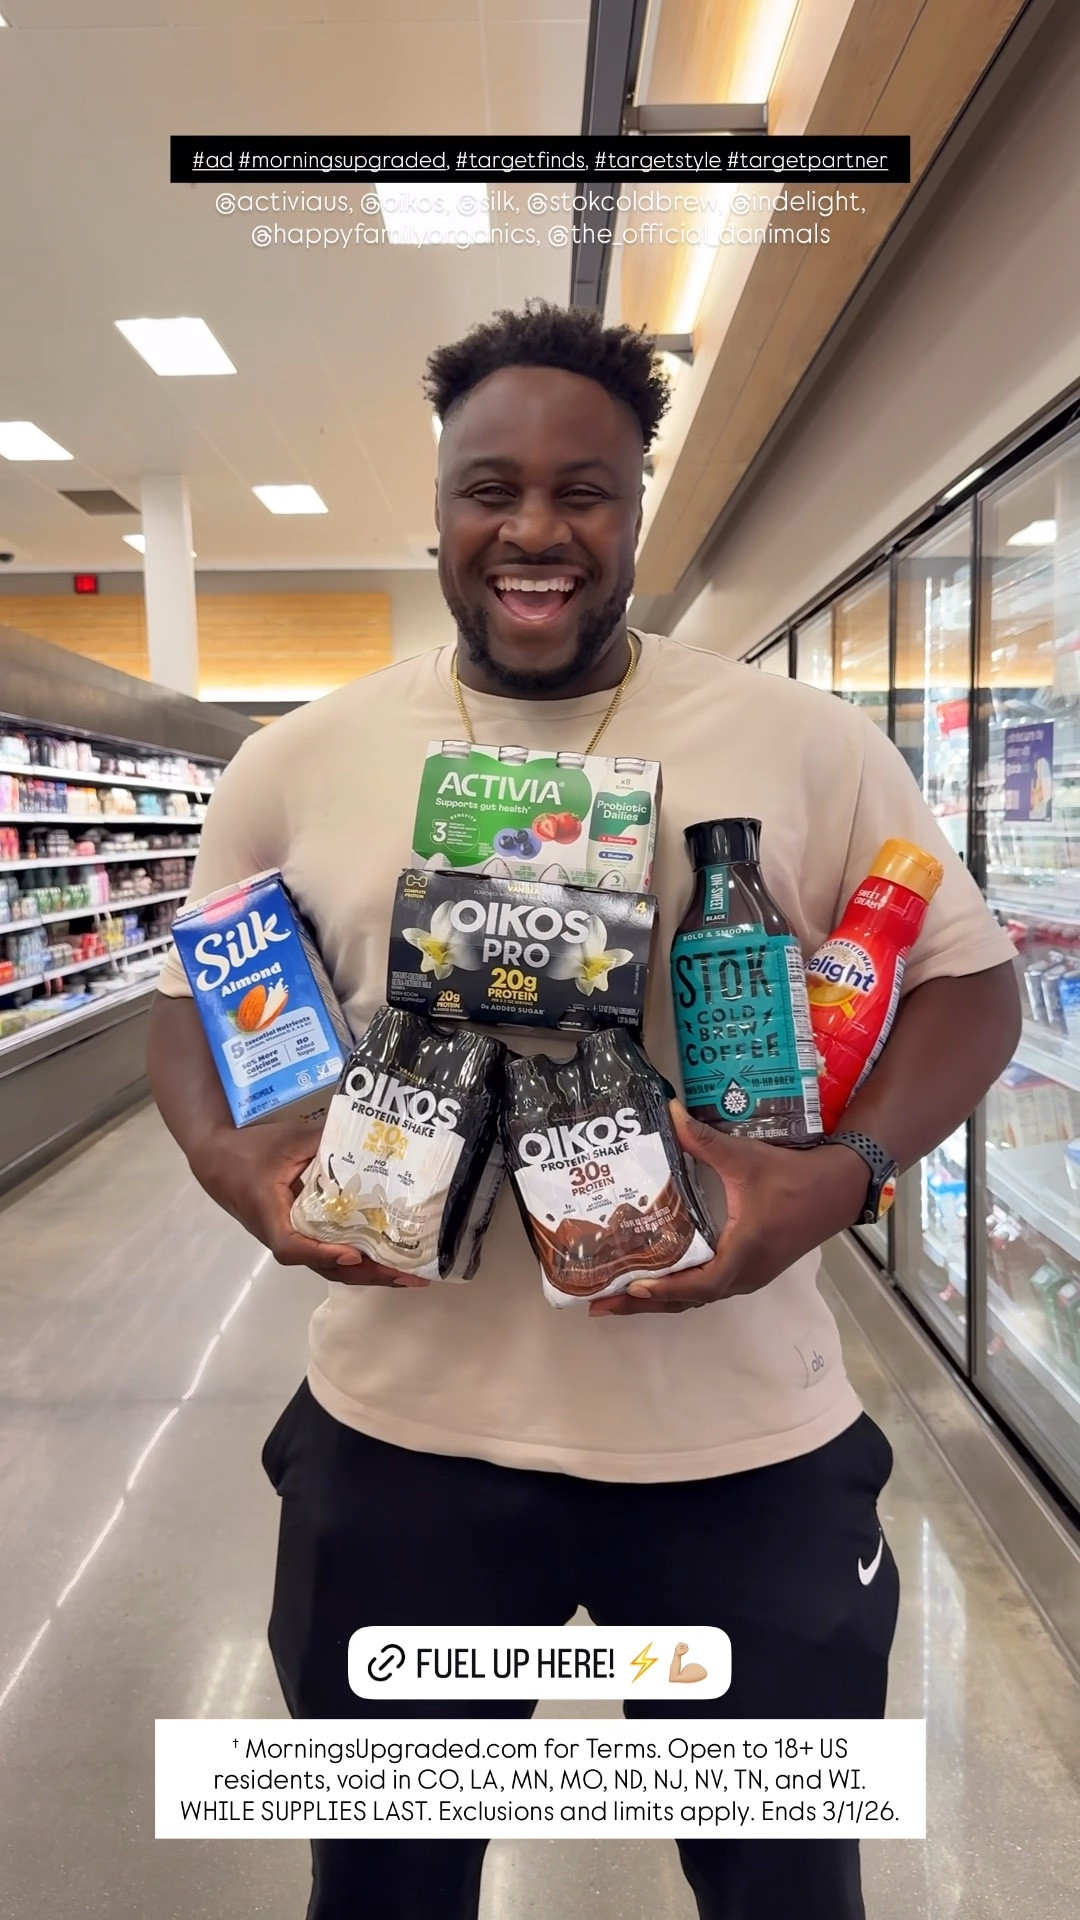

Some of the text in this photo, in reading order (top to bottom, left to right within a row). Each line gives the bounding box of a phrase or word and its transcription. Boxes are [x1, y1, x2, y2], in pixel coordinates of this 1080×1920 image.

[435, 797, 478, 811] Supports
[480, 801, 497, 812] gut
[596, 799, 648, 814] Probiotic
[603, 809, 639, 822] Dailies
[431, 820, 448, 843] 3
[507, 885, 540, 895] VANILLA
[709, 873, 724, 911] UN-SWEET
[857, 889, 880, 900] SWEET
[636, 901, 647, 913] 4
[853, 896, 882, 911] CREAMY
[449, 899, 590, 944] OIKOS
[705, 913, 726, 922] BLACK
[682, 930, 704, 942] BOLD
[715, 925, 754, 938] SMOOTH
[195, 910, 292, 992] Silk
[482, 938, 550, 968] PRO
[820, 939, 873, 971] TERNATIONAL
[221, 961, 282, 998] Almond
[490, 967, 538, 991] 20g
[804, 955, 875, 992] elight
[436, 1001, 461, 1009] PROTEIN
[437, 989, 461, 1003] 20g
[487, 987, 539, 1002] PROTEIN
[490, 1004, 516, 1012] ADDED
[697, 1004, 756, 1025] COLD
[230, 1040, 245, 1060] 5
[244, 1028, 277, 1048] Essential
[276, 1015, 311, 1033] Nutrients
[699, 1021, 758, 1042] BREW
[295, 1041, 315, 1053] Added
[296, 1047, 316, 1058] Sugar
[685, 1031, 780, 1067] COFFEE
[241, 1048, 279, 1071] 50% More
[246, 1056, 279, 1075] Calcium
[751, 1075, 796, 1088] 10-HR BREW
[345, 1066, 462, 1131] OIKOS
[351, 1101, 436, 1138] PROTEIN SHAKE
[367, 1120, 409, 1151] 30g
[518, 1107, 642, 1165] OIKOS
[764, 1127, 789, 1138] BEVERAGE
[362, 1140, 407, 1161] PROTEIN
[540, 1142, 630, 1172] PROTEIN SHAKE
[374, 1159, 387, 1167] NO
[568, 1161, 611, 1187] 30g
[571, 1176, 616, 1197] PROTEIN
[592, 1194, 603, 1202] NO
